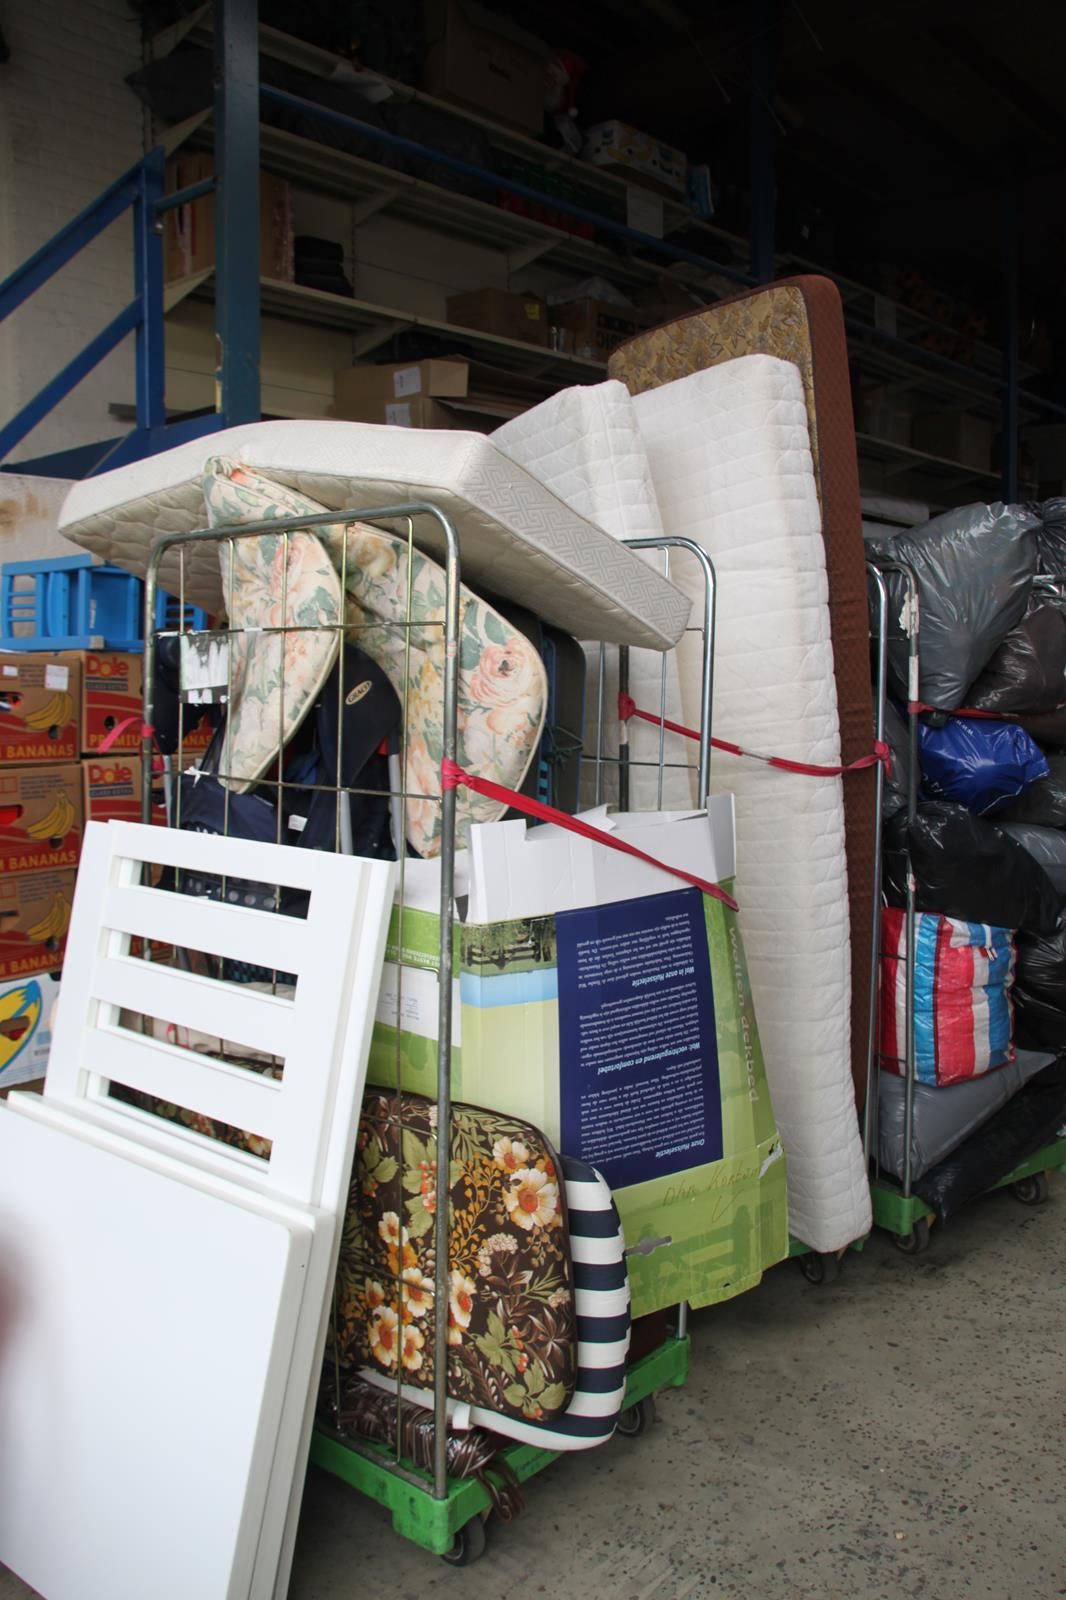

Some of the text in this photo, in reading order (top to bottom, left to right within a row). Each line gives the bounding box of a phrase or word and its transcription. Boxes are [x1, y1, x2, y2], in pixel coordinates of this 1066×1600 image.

[86, 655, 129, 677] Dole
[7, 744, 74, 758] BANANAS
[88, 762, 133, 784] Dole
[9, 850, 77, 870] BANANAS
[631, 966, 695, 988] Wol in onze Huisselectie
[635, 1057, 643, 1065] en
[643, 1046, 688, 1063] vochtregulerend
[741, 1015, 760, 1102] dekbed
[597, 1060, 635, 1075] comfortabel
[655, 1143, 690, 1159] Huisselectie
[690, 1138, 705, 1147] Onze
